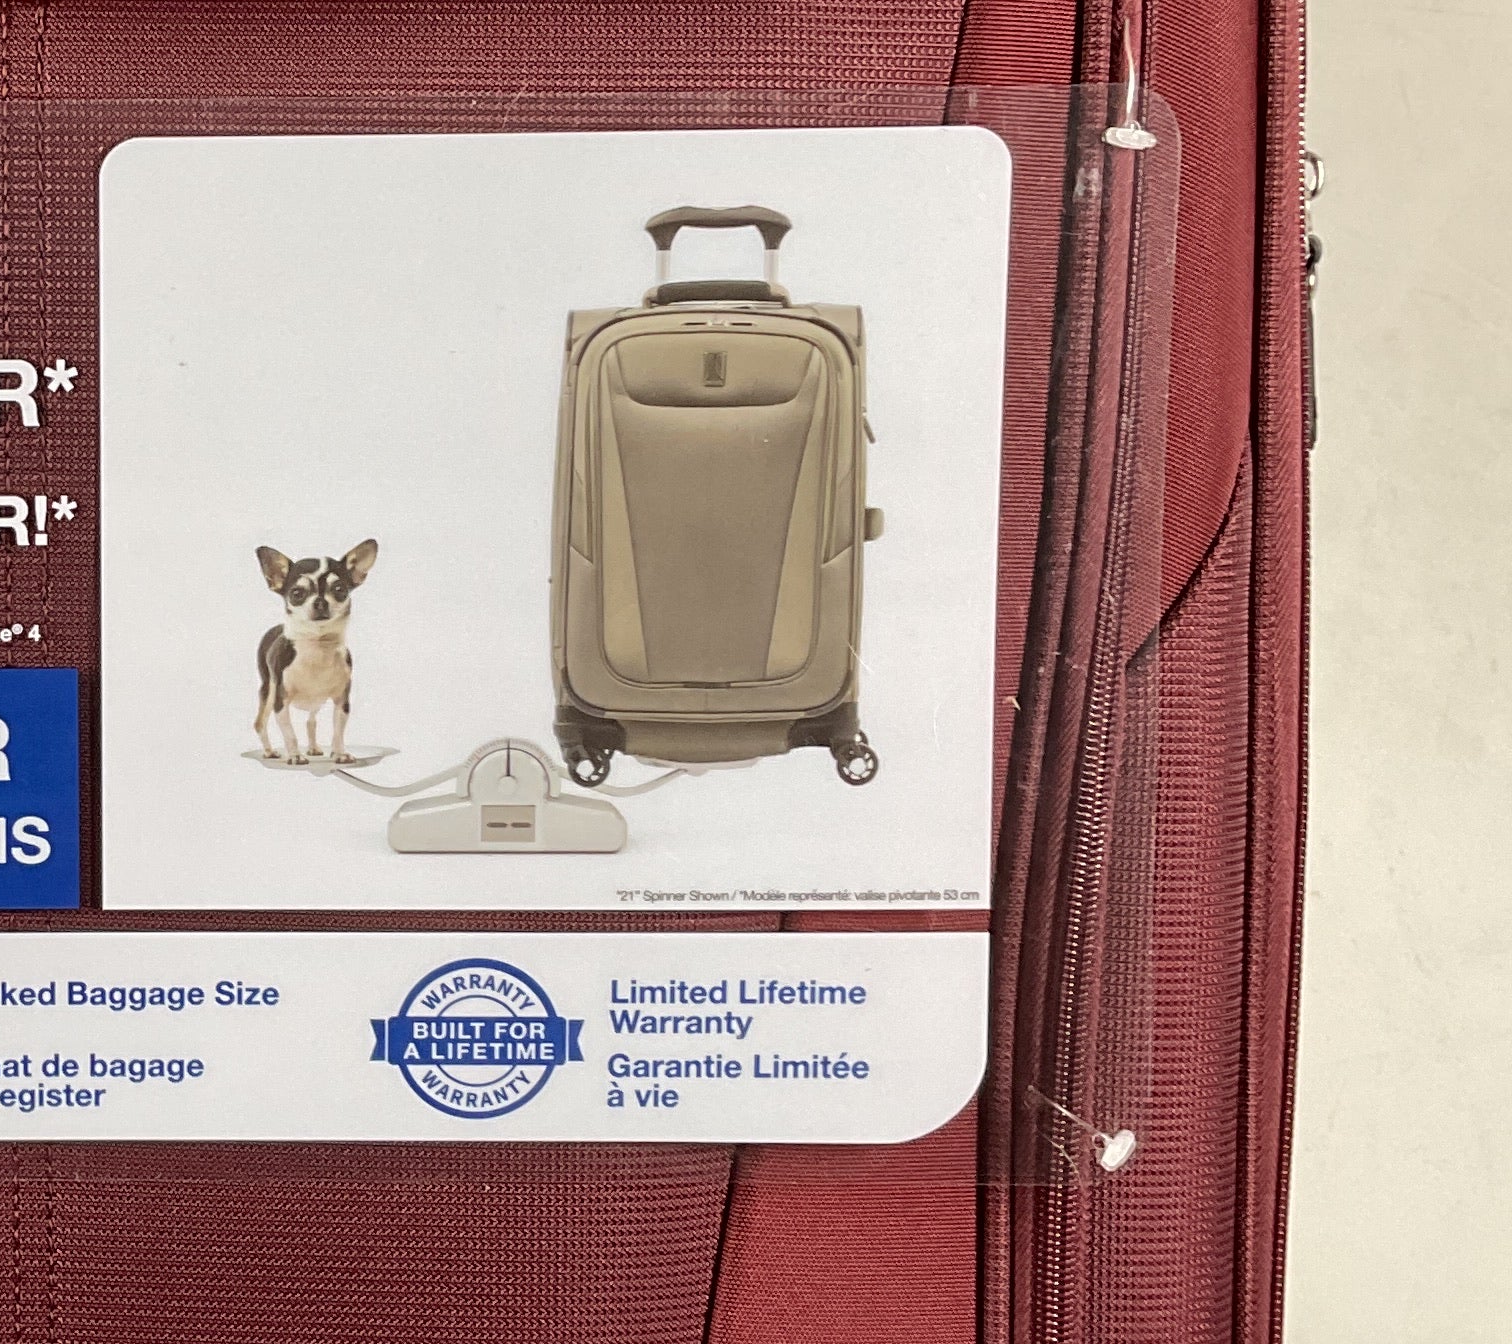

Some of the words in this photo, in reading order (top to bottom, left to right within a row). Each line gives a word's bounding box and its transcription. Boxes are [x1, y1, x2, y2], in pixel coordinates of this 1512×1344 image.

[27, 624, 42, 642] 4
[642, 889, 687, 904] Spinner
[689, 889, 730, 902] Shown
[854, 889, 887, 901] valise
[943, 889, 959, 901] 53
[960, 891, 980, 901] cm
[67, 981, 205, 1012] Baggage
[214, 980, 280, 1006] Size
[421, 973, 535, 1010] WARRANTY
[611, 979, 728, 1005] Limited
[739, 979, 867, 1005] Lifetime
[413, 1022, 485, 1039] BUILT
[494, 1022, 546, 1039] FOR
[609, 1009, 754, 1040] Warranty
[403, 1043, 420, 1060] A
[431, 1043, 555, 1060] LIFETIME
[41, 1053, 79, 1078] de
[89, 1053, 204, 1083] bagage
[607, 1053, 742, 1079] Garantie
[753, 1052, 870, 1079] Limitée
[422, 1070, 531, 1107] WARRANTY
[607, 1081, 624, 1108] à
[634, 1083, 679, 1108] vie
